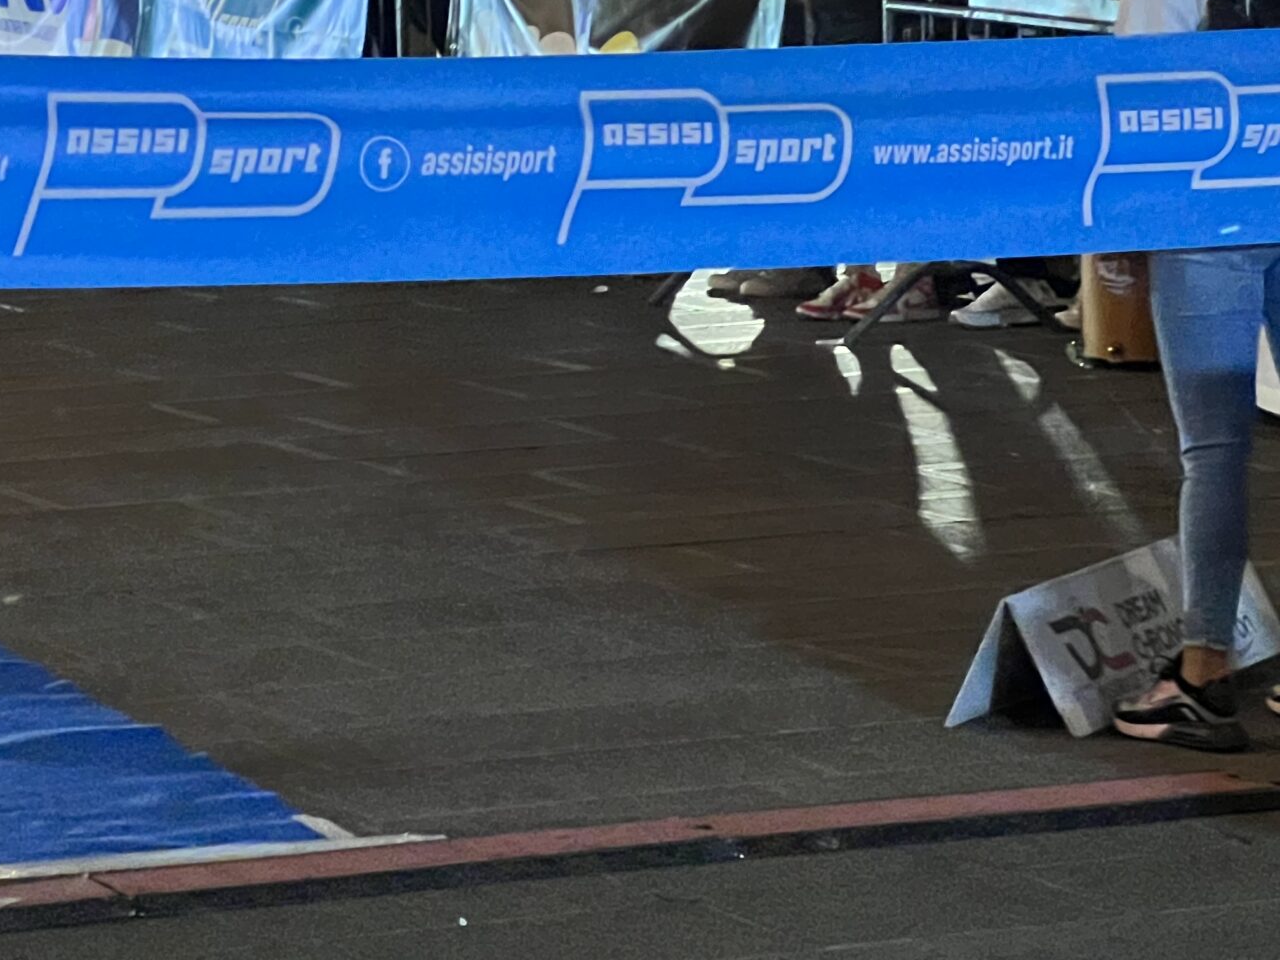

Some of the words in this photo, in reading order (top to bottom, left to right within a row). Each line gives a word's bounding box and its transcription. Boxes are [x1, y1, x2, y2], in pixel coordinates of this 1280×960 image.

[1119, 107, 1223, 132] assisi
[67, 128, 189, 154] assisi
[208, 143, 321, 182] sport
[421, 144, 556, 180] assisisport
[603, 122, 713, 145] assisi
[735, 133, 836, 171] sport
[874, 135, 1073, 165] www.assisisport.it
